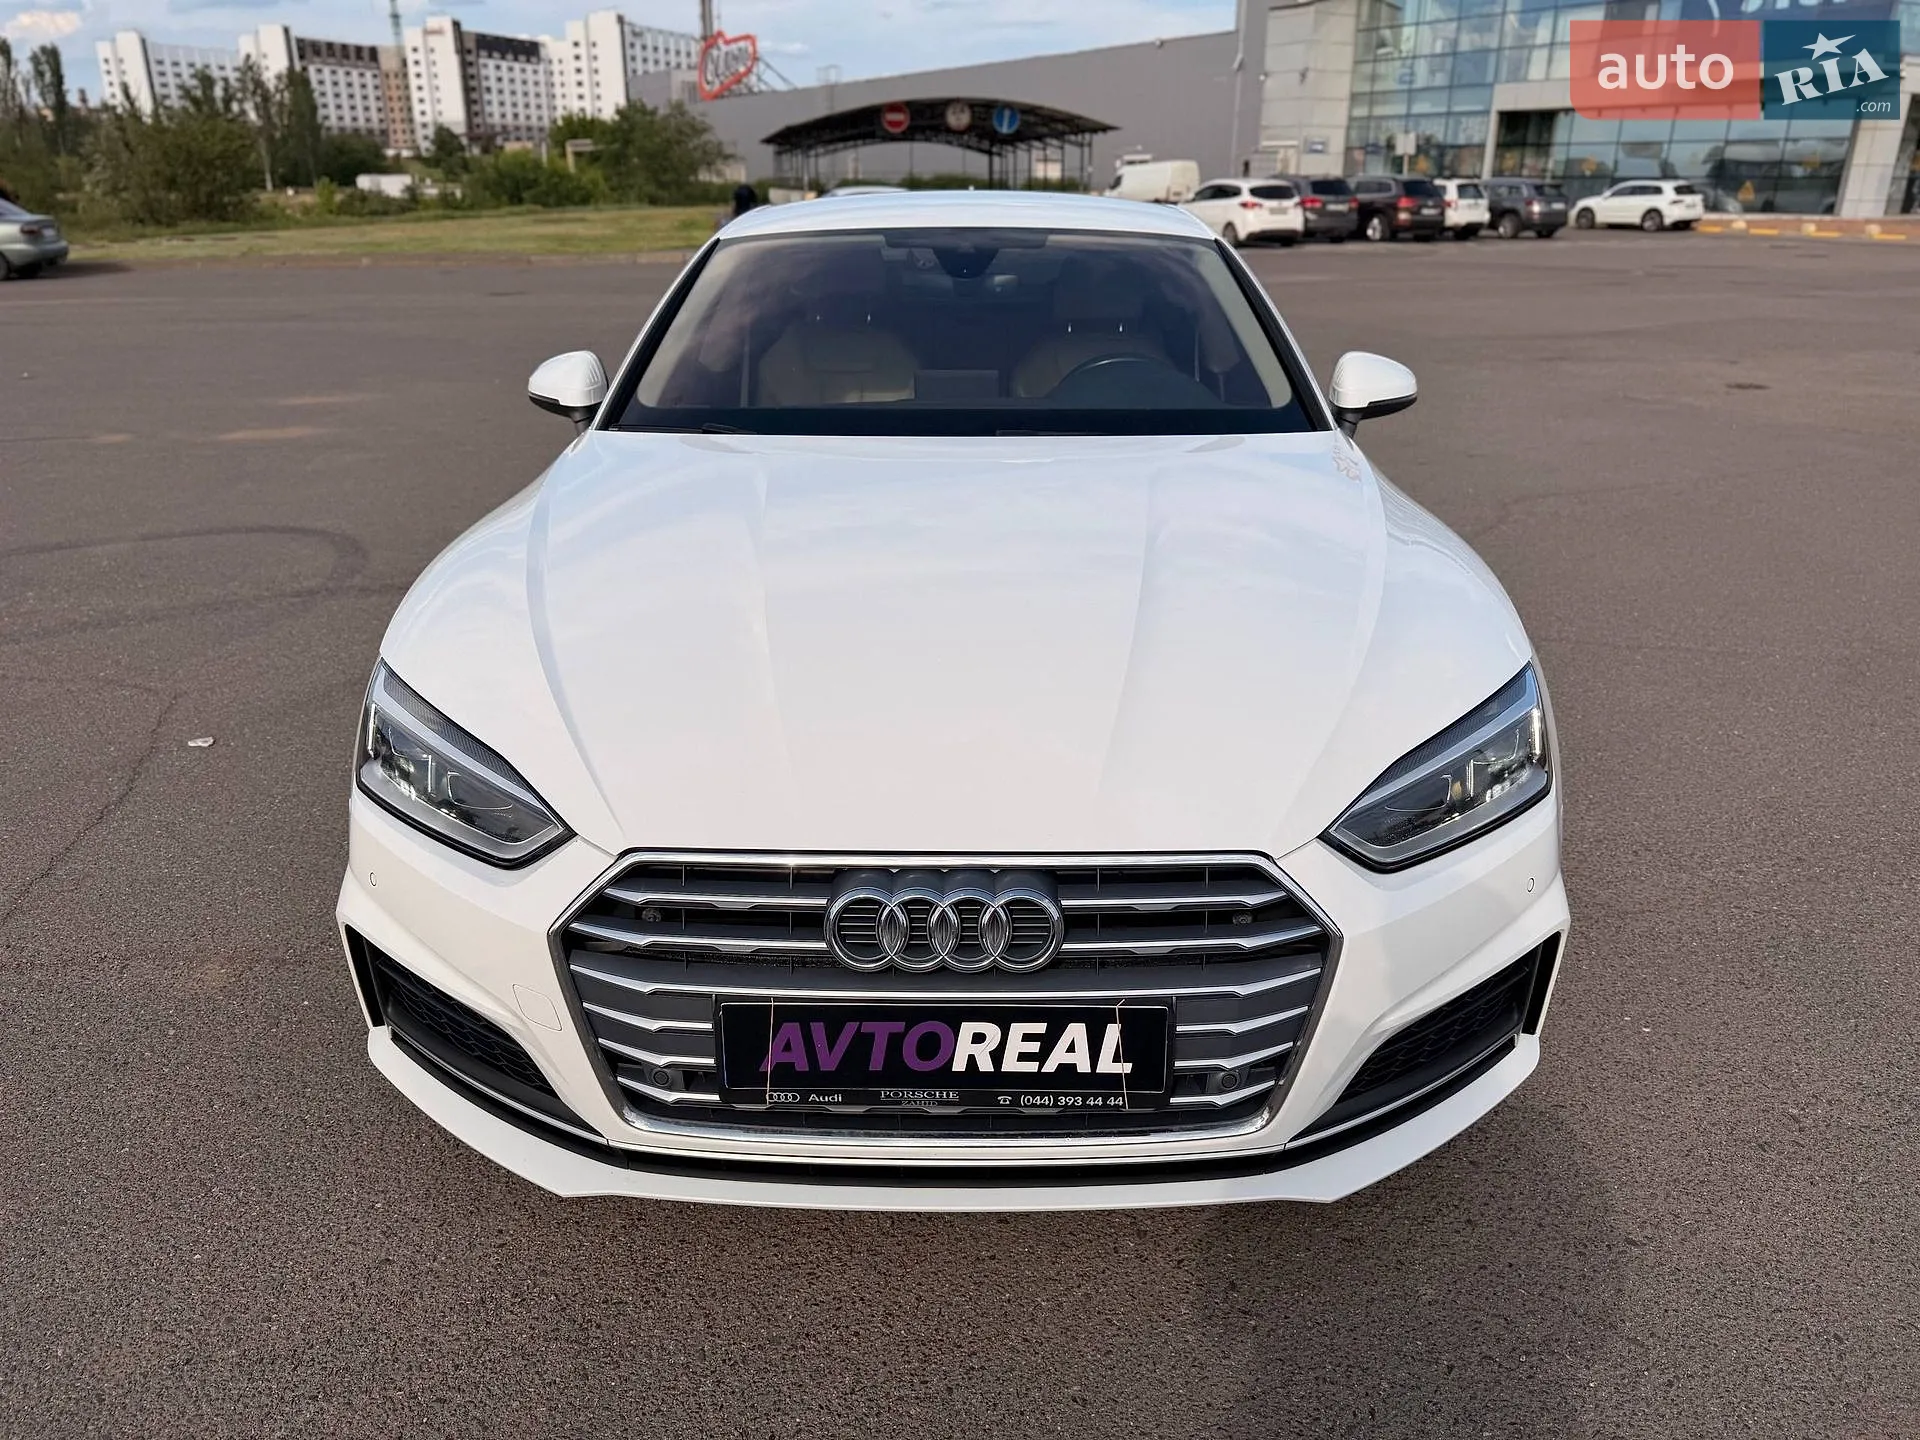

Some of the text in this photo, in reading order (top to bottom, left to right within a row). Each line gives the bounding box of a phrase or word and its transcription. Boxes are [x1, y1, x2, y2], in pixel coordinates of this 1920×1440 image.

[759, 1020, 1133, 1074] AVTOREAL
[808, 1093, 842, 1102] Audi
[880, 1090, 959, 1099] PORSCHE
[1020, 1095, 1123, 1106] (044) 393 44 44
